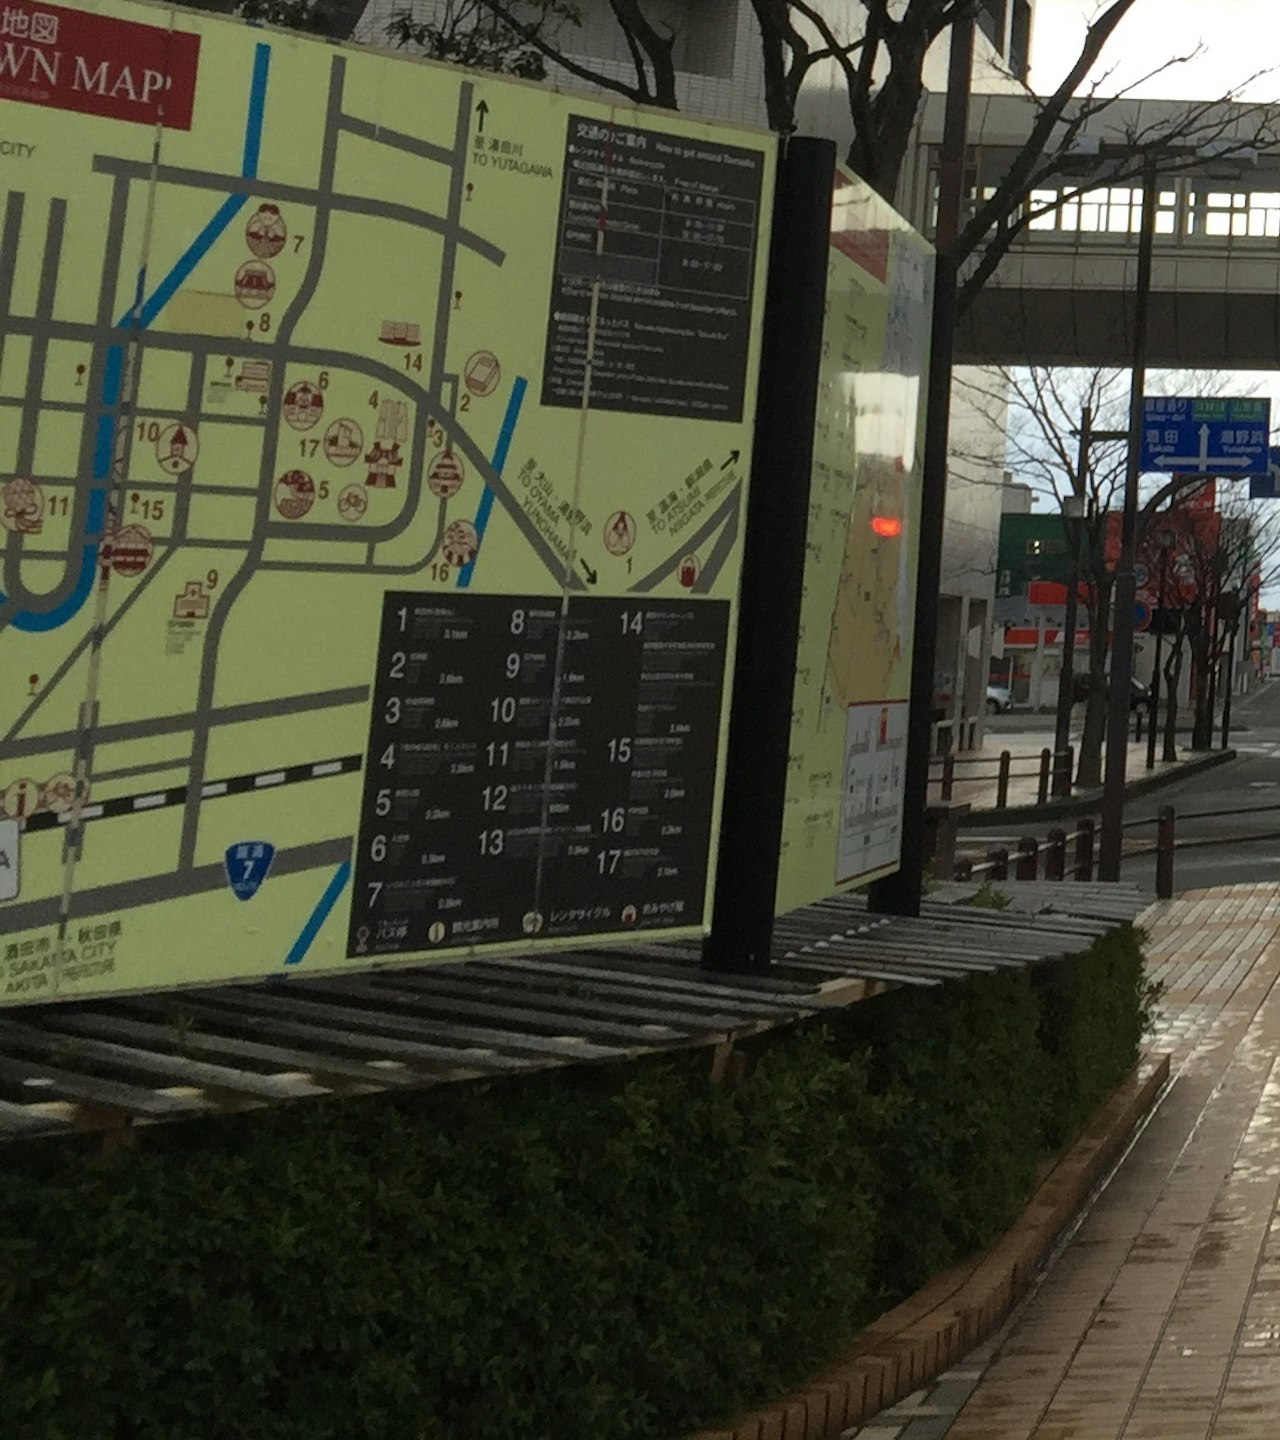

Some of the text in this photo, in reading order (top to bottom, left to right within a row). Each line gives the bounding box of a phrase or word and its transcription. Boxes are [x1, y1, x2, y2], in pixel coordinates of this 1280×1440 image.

[72, 55, 166, 103] MAP
[473, 152, 488, 166] TO
[293, 235, 305, 253] 7
[259, 312, 271, 332] 8
[403, 353, 422, 372] 14
[318, 371, 329, 390] 6
[368, 390, 378, 409] 4
[460, 395, 470, 412] 2
[137, 421, 160, 442] 10
[299, 439, 320, 458] 17
[317, 479, 329, 500] 5
[517, 467, 532, 488] TO
[48, 495, 69, 517] 11
[141, 499, 165, 522] 15
[650, 518, 666, 535] TO
[431, 563, 450, 583] 16
[626, 557, 633, 575] 1
[206, 569, 219, 590] 9
[397, 606, 408, 632] 1
[510, 608, 525, 635] 8
[620, 610, 643, 635] 14
[389, 651, 406, 679] 2
[505, 652, 520, 679] 9
[384, 696, 401, 725] 3
[491, 696, 516, 724] 10
[379, 743, 395, 771] 4
[486, 740, 510, 767] 11
[608, 737, 632, 763] 15
[375, 788, 392, 817] 5
[482, 784, 508, 812] 12
[600, 806, 626, 834] 16
[370, 833, 387, 863] 6
[478, 828, 504, 856] 13
[243, 860, 255, 880] 7
[597, 849, 622, 876] 17
[367, 881, 384, 909] 7
